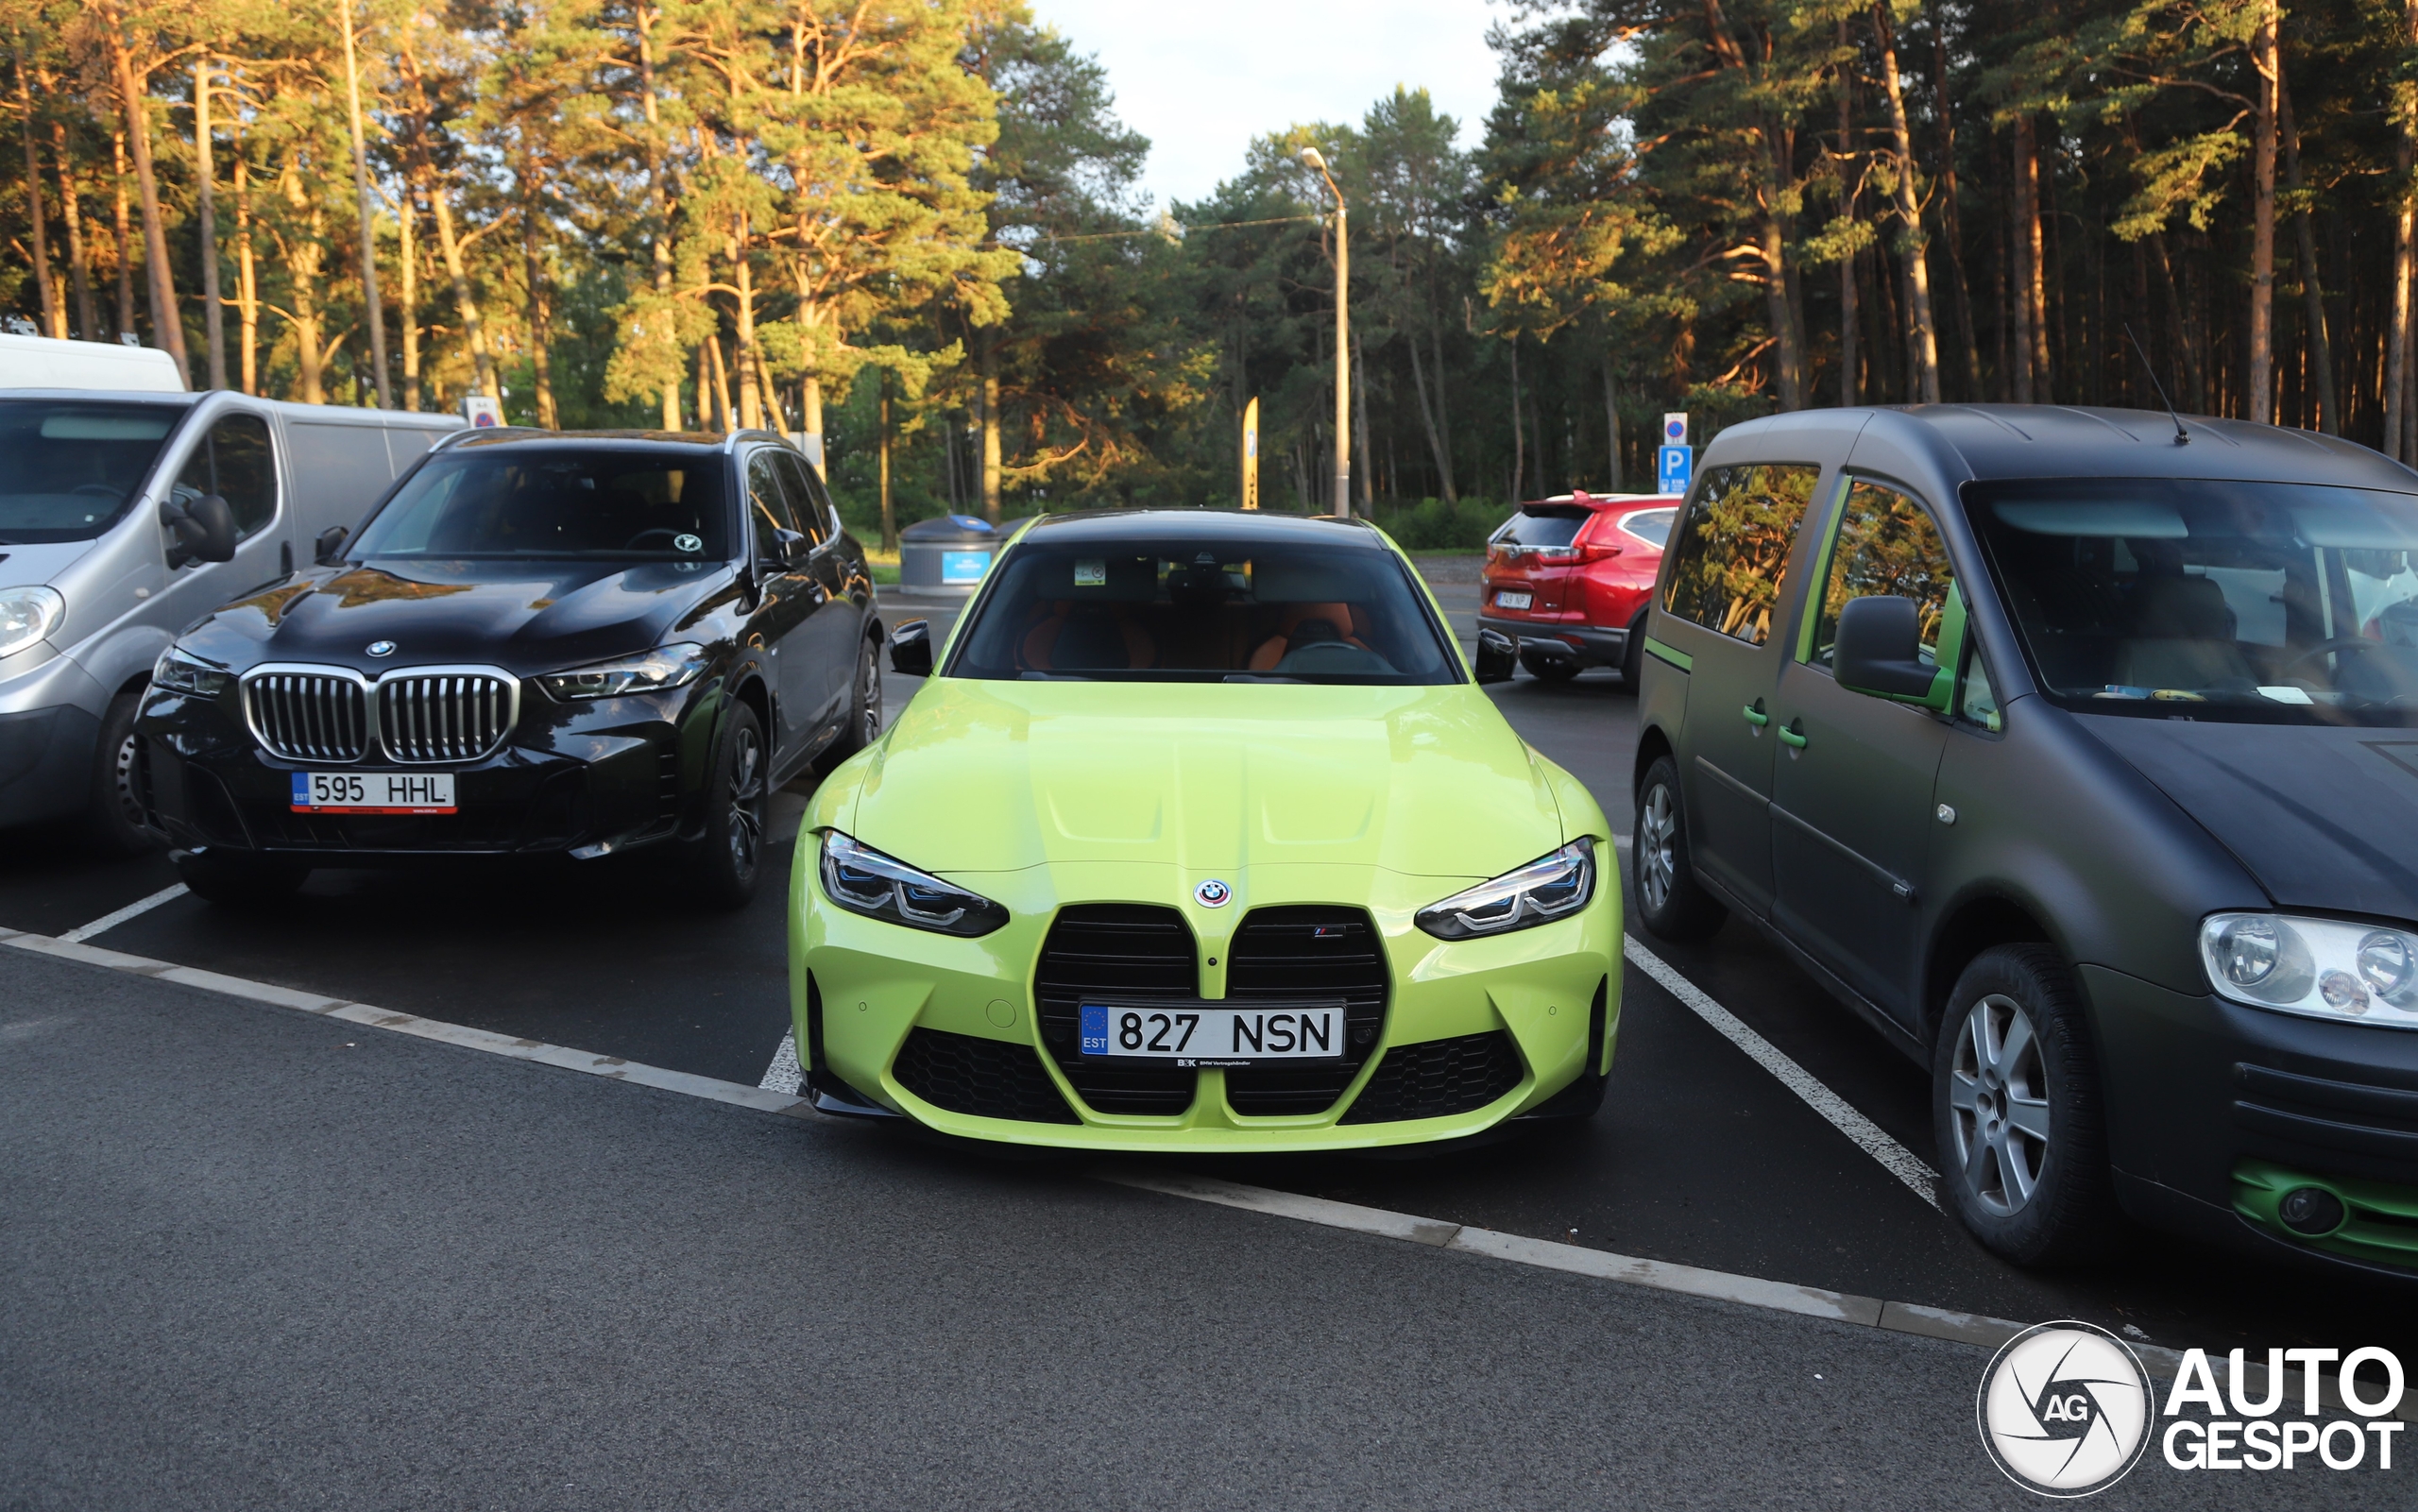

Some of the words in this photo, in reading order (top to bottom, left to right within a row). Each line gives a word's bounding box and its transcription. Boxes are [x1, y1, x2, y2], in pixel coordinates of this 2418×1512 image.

[1666, 450, 1684, 476] P
[315, 775, 365, 802] 595
[388, 776, 446, 803] HHL
[1083, 1037, 1107, 1048] EST
[1119, 1011, 1200, 1052] 827
[1233, 1013, 1330, 1053] NSN
